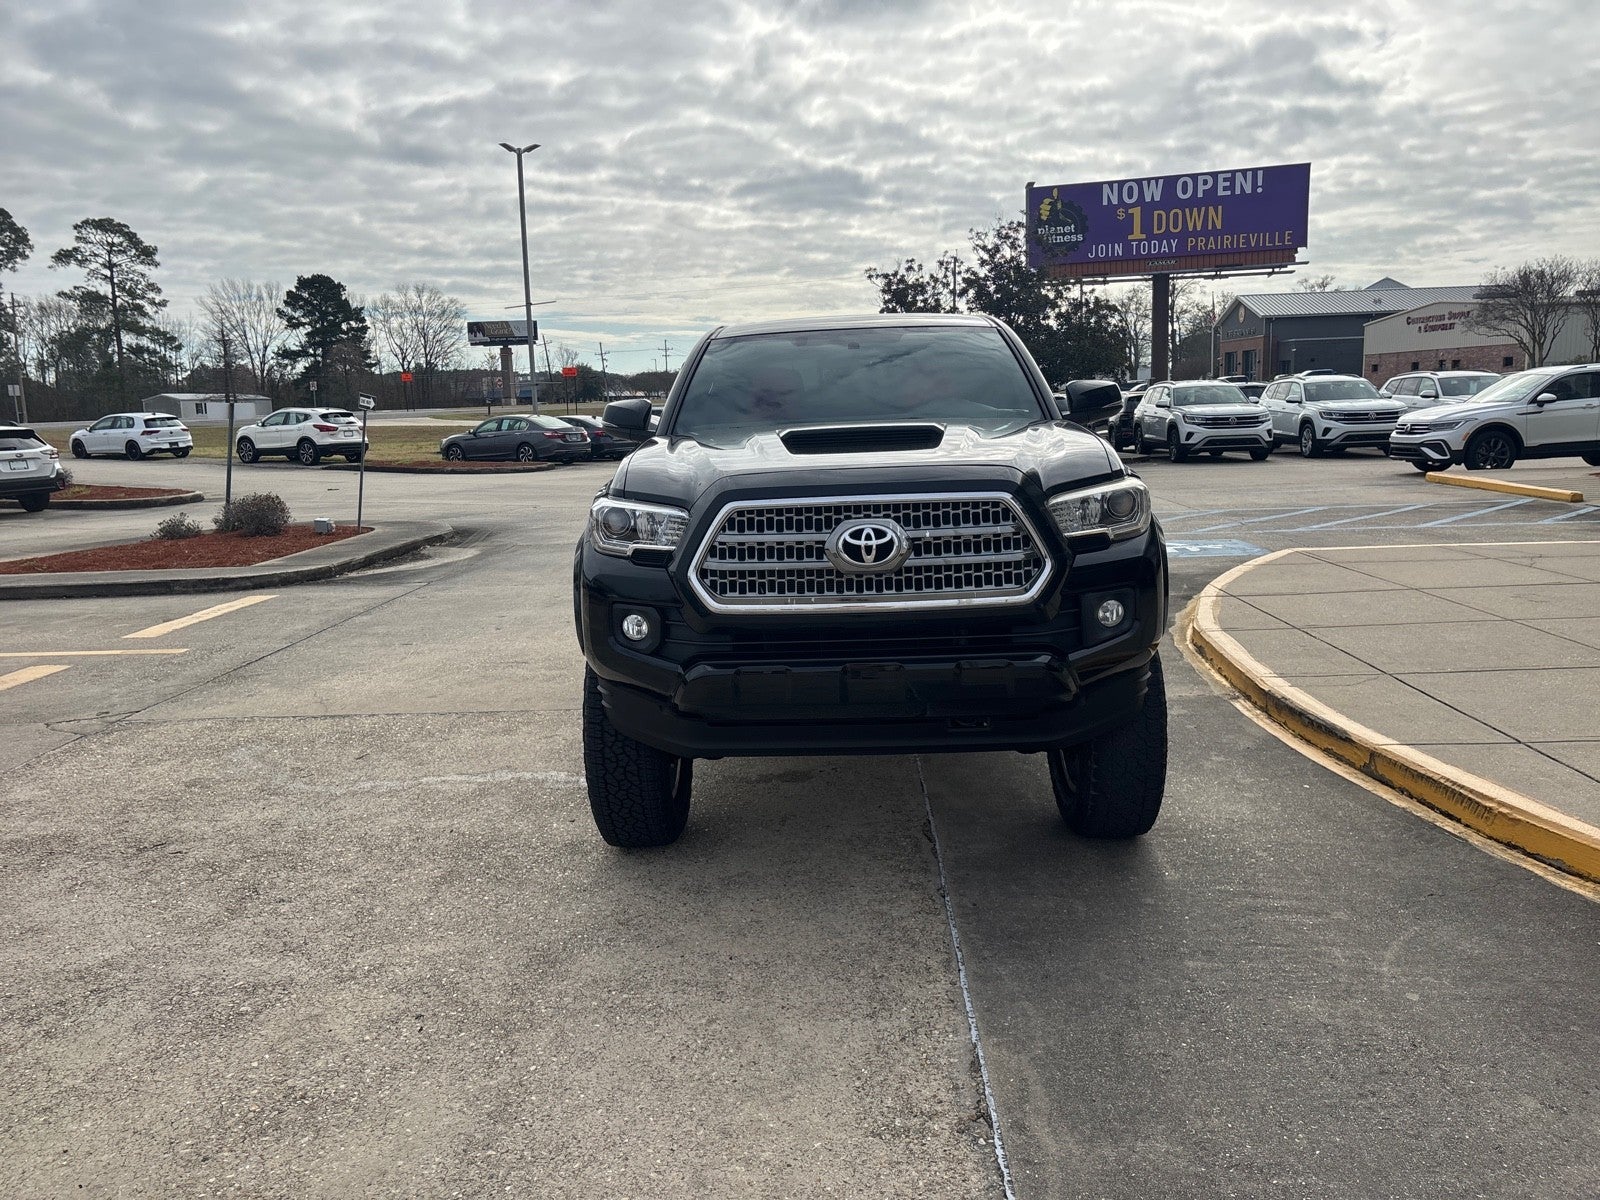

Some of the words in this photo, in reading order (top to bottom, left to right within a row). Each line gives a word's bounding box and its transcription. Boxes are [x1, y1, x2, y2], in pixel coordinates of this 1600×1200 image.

[1102, 178, 1164, 206] NOW
[1176, 170, 1264, 199] OPEN!
[1153, 206, 1223, 234] DOWN
[1088, 243, 1123, 259] JOIN
[1131, 238, 1178, 255] TODAY
[1187, 230, 1293, 251] PRAIRIEVILLE
